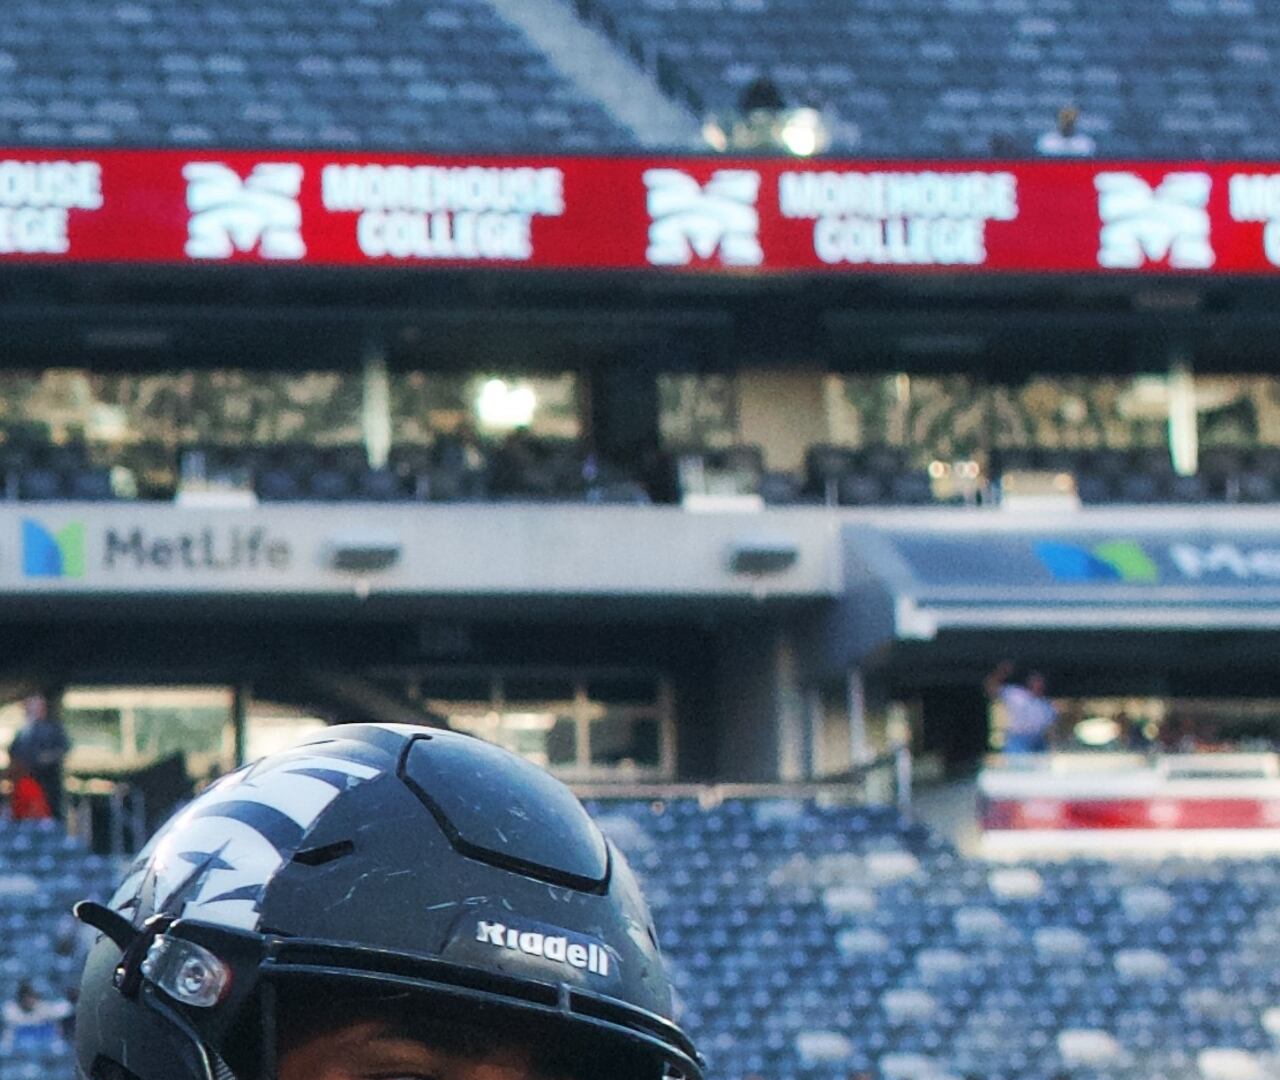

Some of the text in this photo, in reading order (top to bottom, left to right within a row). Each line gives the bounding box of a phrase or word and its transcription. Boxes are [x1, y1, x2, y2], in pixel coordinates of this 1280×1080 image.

[321, 164, 564, 216] MOREHOUSE
[778, 171, 1019, 221] MOREHOUSE
[357, 210, 533, 260] COLLEGE
[813, 216, 987, 265] COLLEGE
[104, 524, 290, 570] MetLife
[476, 920, 608, 977] Riddell
